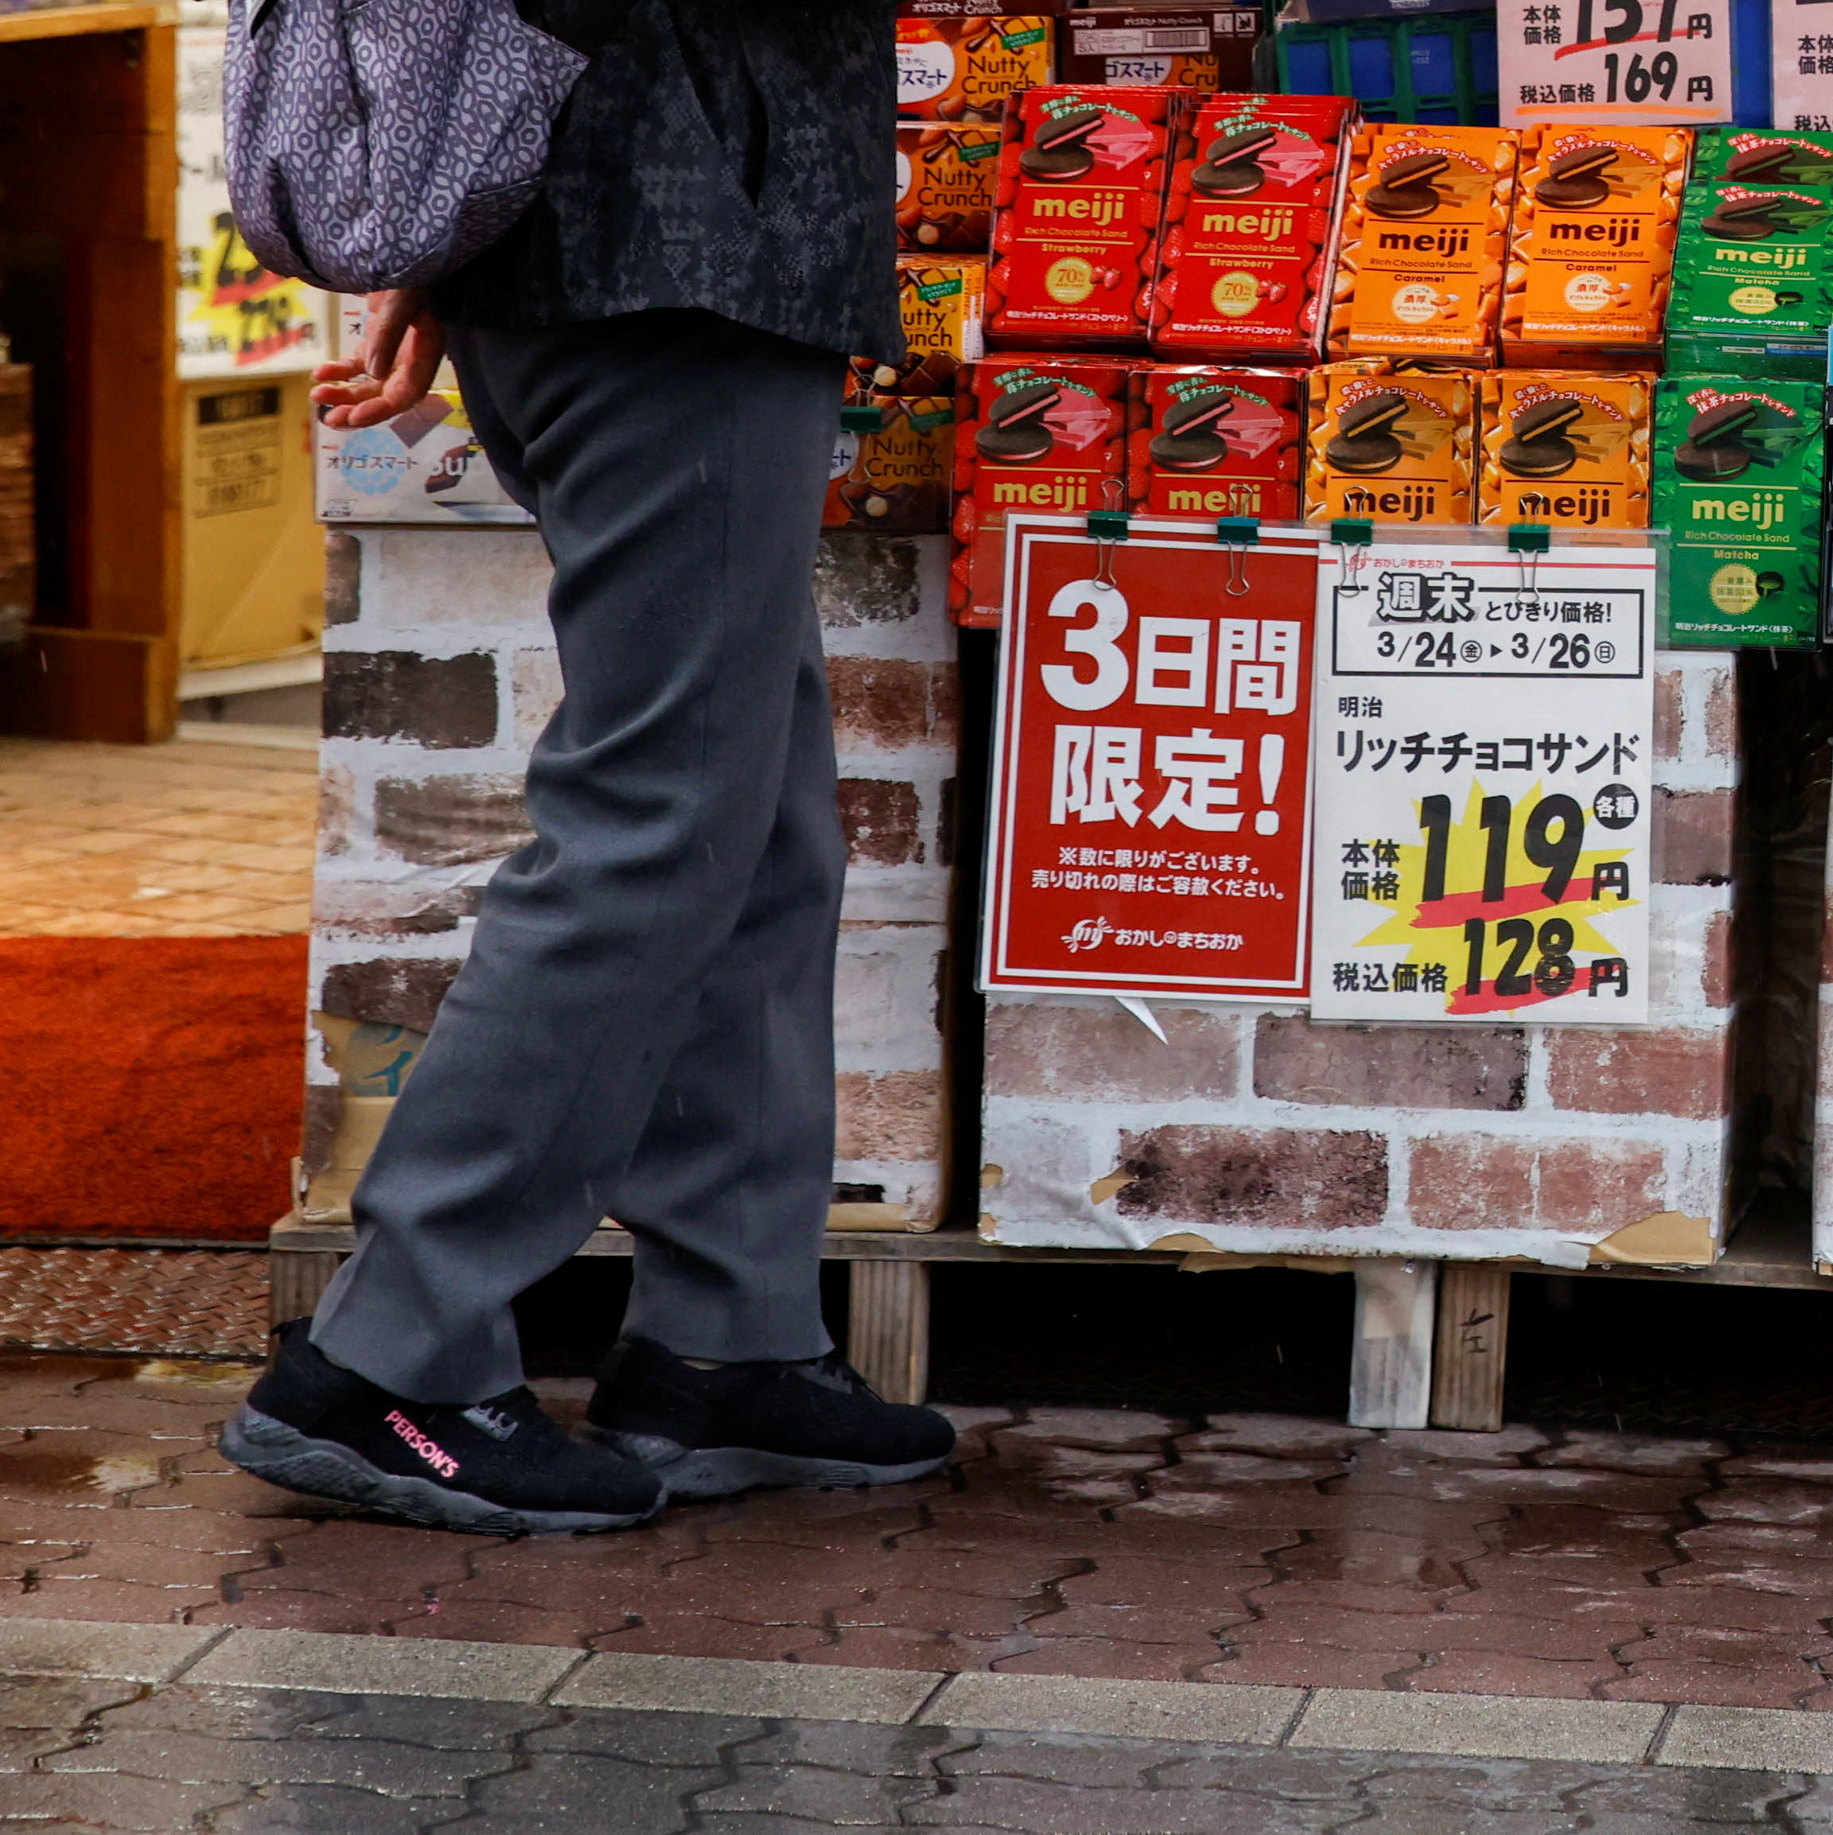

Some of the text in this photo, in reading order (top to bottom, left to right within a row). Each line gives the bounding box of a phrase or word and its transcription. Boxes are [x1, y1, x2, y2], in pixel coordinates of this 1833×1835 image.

[923, 168, 985, 191] Nutty
[918, 187, 992, 209] Crunch
[1033, 194, 1125, 226] meiji
[1042, 243, 1107, 255] Strawberry
[1379, 229, 1468, 257] meiji
[1550, 219, 1640, 248] meiji
[1395, 273, 1446, 283] Caramel
[1692, 493, 1784, 530] meiji
[1714, 549, 1760, 561] Matcha
[1376, 573, 1612, 624] 週末 とびきり価格!
[1041, 580, 1301, 716] 3日間
[1336, 731, 1640, 776] リッチチョコサンド
[1050, 725, 1285, 836] 限定!
[1031, 869, 1285, 900] 売り切れの際はご容赦ください。
[1333, 962, 1448, 994] 税込価格
[383, 1408, 460, 1480] PERSON'S
